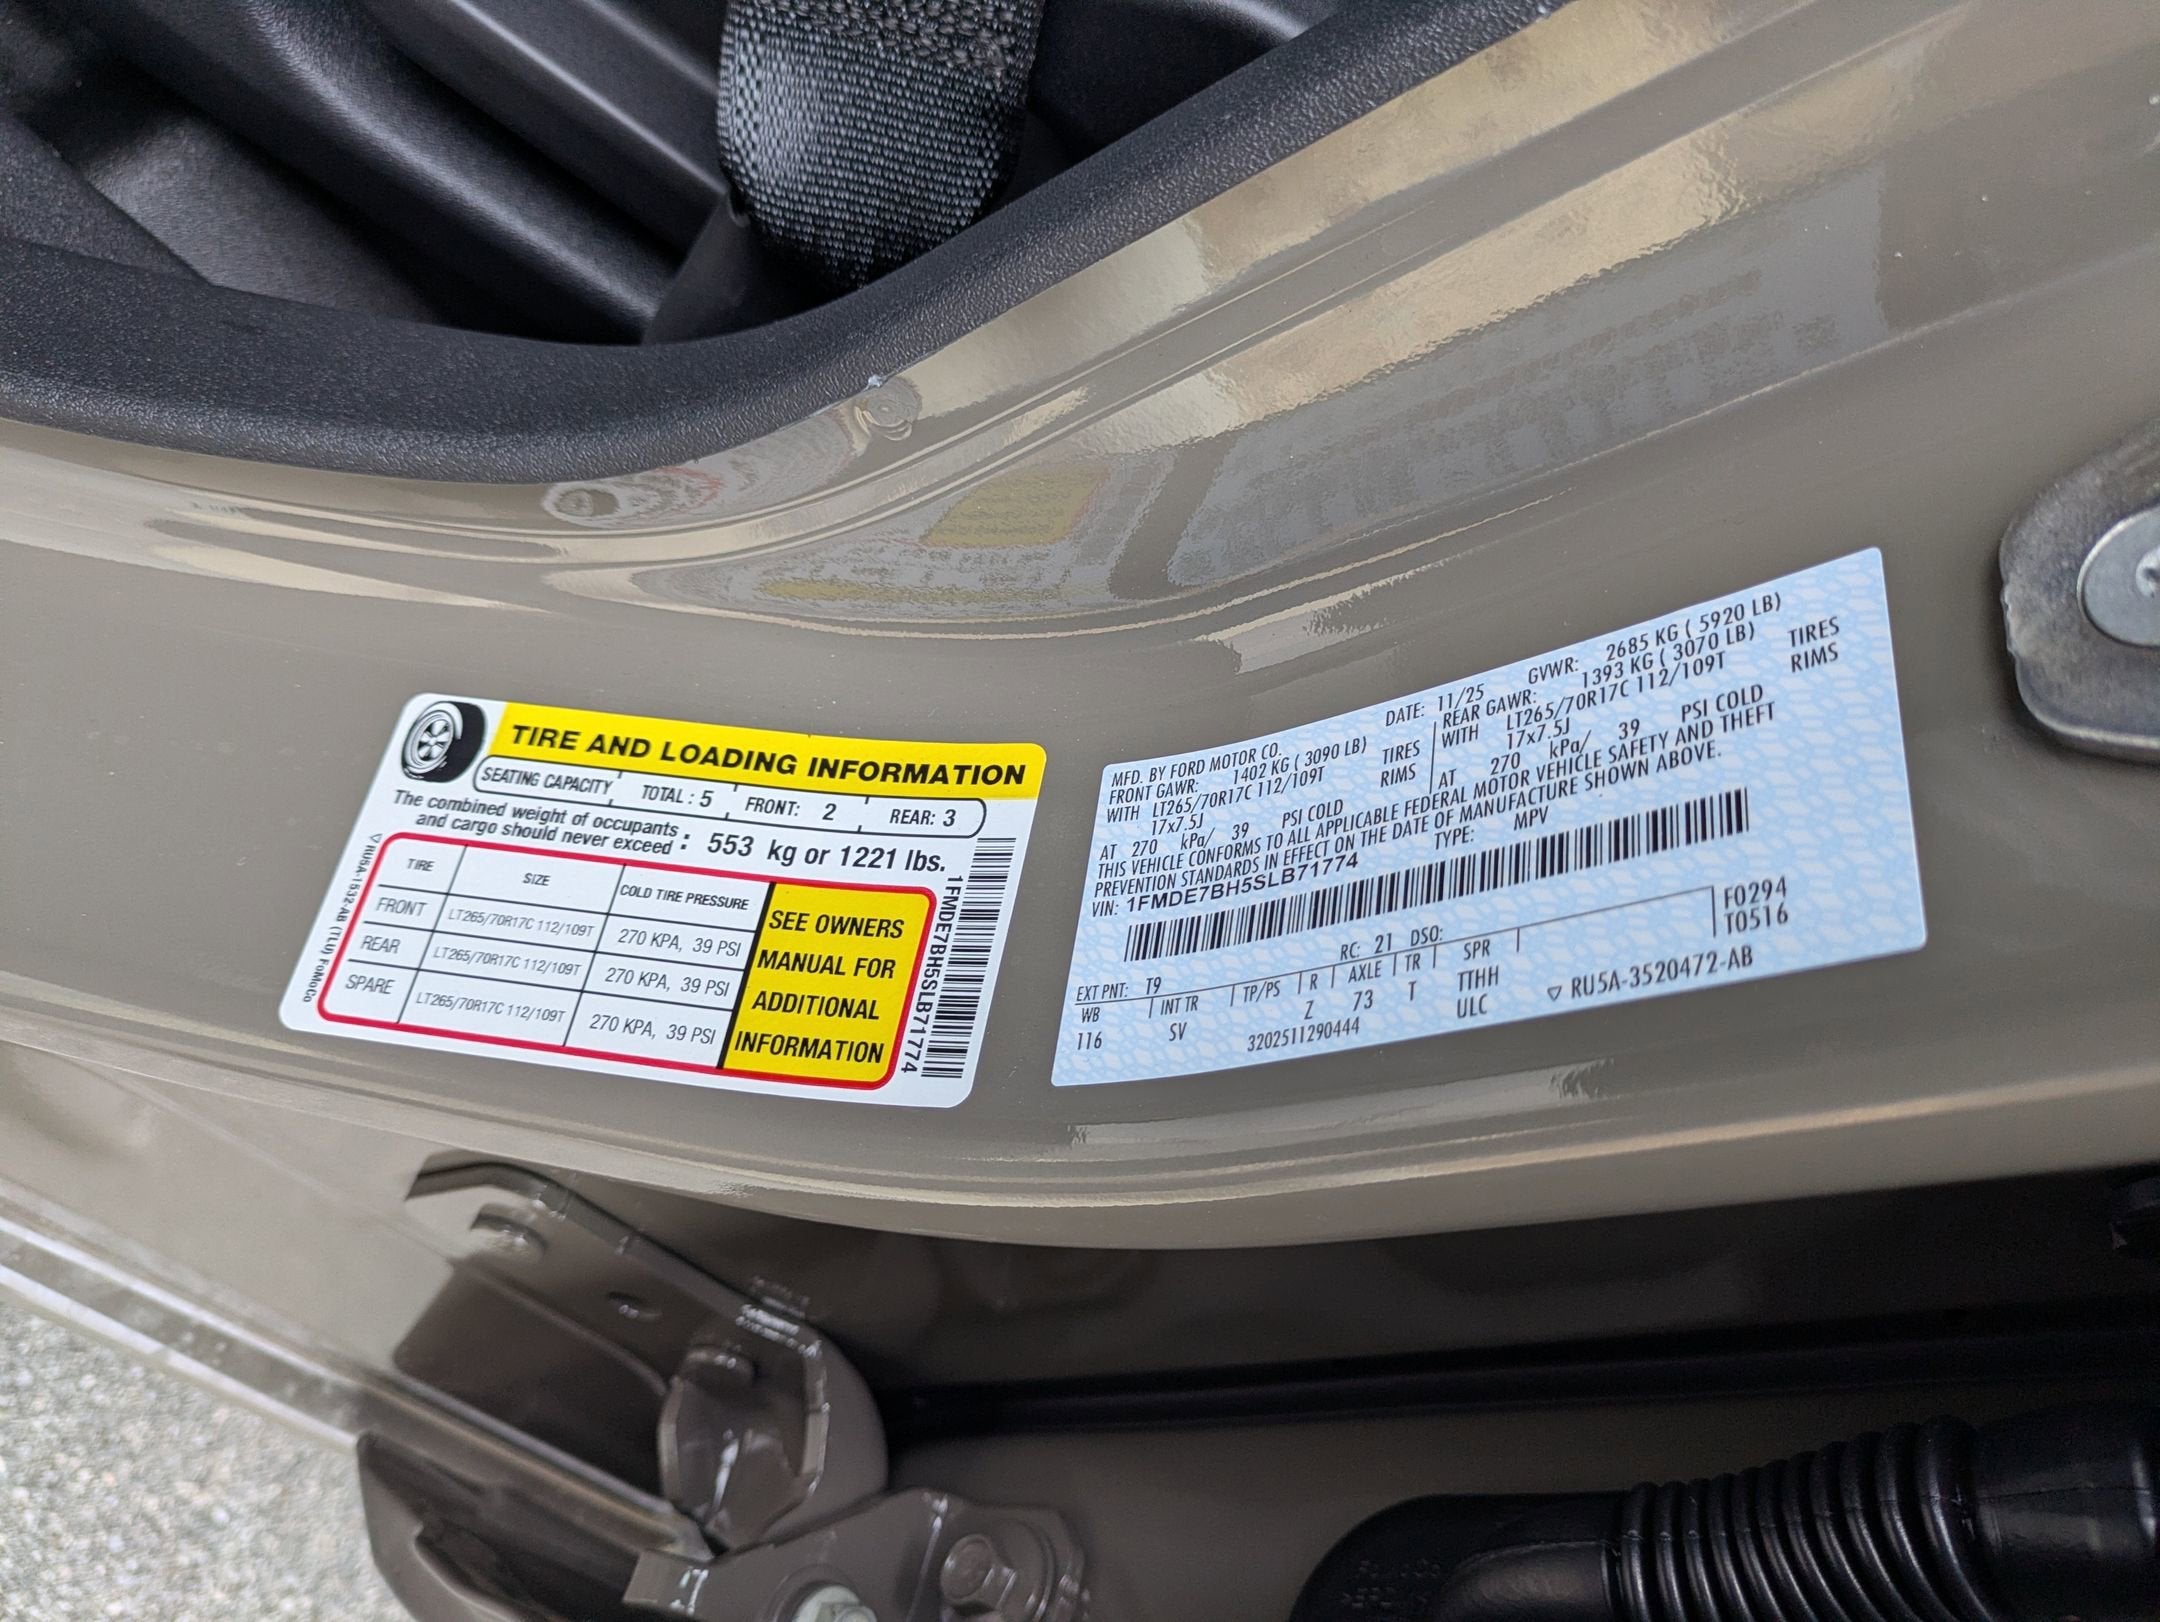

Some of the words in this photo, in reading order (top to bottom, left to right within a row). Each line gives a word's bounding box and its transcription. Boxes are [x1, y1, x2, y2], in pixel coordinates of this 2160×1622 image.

[1528, 657, 1579, 684] GVWR:
[1607, 633, 1648, 662] 2685
[1656, 624, 1679, 647] KG
[1700, 603, 1745, 632] 5920
[1752, 592, 1781, 616] LB)
[1442, 724, 1478, 748] WITH
[1507, 680, 1629, 731] LT265/70R17C
[1637, 651, 1725, 693] 112/109T
[1788, 616, 1840, 648] TIRES
[1443, 704, 1480, 729] REAR
[1486, 689, 1537, 716] GAWR:
[1583, 662, 1624, 688] 1393
[1631, 652, 1653, 674] KG
[1673, 632, 1719, 661] 3070
[1726, 621, 1755, 646] LB)
[1386, 702, 1424, 726] DATE:
[1439, 684, 1484, 711] 11/25
[1508, 717, 1570, 749] 17x7.5J
[1791, 642, 1839, 673] RIMS
[1438, 769, 1456, 789] AT
[1491, 752, 1521, 776] 270
[1550, 730, 1591, 759] kPa/
[1618, 718, 1640, 740] 39
[1681, 699, 1708, 723] PSI
[1716, 684, 1763, 712] COLD
[512, 725, 580, 750] TIRE
[587, 735, 651, 759] AND
[660, 741, 797, 775] LOADING
[808, 758, 1025, 785] INFORMATION
[1112, 770, 1142, 786] MFD.
[1150, 767, 1166, 782] BY
[1170, 760, 1205, 779] FORD
[1209, 749, 1256, 772] MOTOR
[1261, 742, 1282, 758] CO.
[482, 767, 539, 787] SEATING
[543, 773, 613, 795] CAPACITY
[1107, 806, 1140, 823] WITH
[1153, 784, 1251, 817] LT265/70R17C
[1258, 766, 1325, 798] 112/109T
[1382, 740, 1421, 764] TIRES
[1109, 785, 1152, 804] FRONT
[1156, 779, 1199, 798] GAWR:
[1234, 763, 1266, 784] 1402
[1271, 757, 1289, 775] KG
[1305, 743, 1339, 766] 3090
[1345, 736, 1367, 756] LB)
[642, 785, 683, 803] TOTAL
[699, 790, 713, 807] 5
[1099, 861, 1126, 879] THIS
[1132, 853, 1184, 875] VEHICLE
[1189, 838, 1261, 867] CONFORMS
[1267, 833, 1283, 849] TO
[1287, 828, 1310, 846] ALL
[1315, 803, 1399, 839] APPLICABLE
[1404, 786, 1465, 817] FEDERAL
[1474, 769, 1529, 800] MOTOR
[1537, 749, 1602, 781] VEHICLE
[1608, 731, 1668, 764] SAFETY
[1675, 720, 1713, 746] AND
[1720, 701, 1775, 733] THEFT
[1152, 813, 1204, 835] 17x7.5J
[1380, 763, 1416, 787] RIMS
[395, 790, 422, 806] The
[427, 795, 505, 816] combined
[512, 804, 566, 827] weight
[572, 811, 588, 826] of
[592, 817, 679, 839] occupants
[746, 797, 800, 816] FRONT:
[823, 804, 836, 820] 2
[890, 809, 936, 826] REAR:
[943, 810, 956, 827] 3
[1095, 874, 1176, 897] PREVENTION
[1182, 856, 1259, 887] STANDARDS
[1265, 852, 1278, 870] IN
[1283, 840, 1330, 866] EFFECT
[1335, 833, 1355, 853] ON
[1361, 827, 1386, 847] THE
[1392, 816, 1428, 839] DATE
[1434, 809, 1454, 828] OF
[1460, 777, 1578, 823] MANUFACTURE
[1585, 758, 1649, 791] SHOWN
[1656, 740, 1721, 773] ABOVE.
[416, 811, 446, 828] and
[451, 818, 498, 837] cargo
[502, 823, 557, 841] should
[561, 832, 610, 847] never
[613, 834, 673, 854] exceed
[1100, 844, 1117, 860] AT
[1132, 839, 1158, 857] 270
[1181, 827, 1215, 850] kPa/
[1232, 822, 1249, 840] 39
[1282, 808, 1302, 829] PSI
[1308, 800, 1344, 822] COLD
[1434, 827, 1474, 850] TYPE:
[1514, 806, 1548, 831] MPV
[406, 859, 434, 871] TIRE
[708, 833, 754, 855] 553
[768, 840, 796, 868] kg
[804, 848, 830, 865] or
[841, 846, 896, 868] 1221
[905, 850, 945, 871] lbs.
[523, 873, 550, 886] SIZE
[1092, 900, 1118, 917] VIN:
[1127, 852, 1358, 912] 1FMDE7BH5SLB71774
[376, 898, 427, 916] FRONT
[620, 885, 652, 898] COLD
[656, 889, 683, 903] TIRE
[685, 893, 749, 910] PRESSURE
[448, 909, 534, 929] LT265/70R17C
[538, 916, 594, 937] 112/109T
[769, 910, 810, 931] SEE
[816, 914, 904, 938] OWNERS
[320, 926, 343, 954] (TLU)
[361, 936, 400, 954] REAR
[618, 929, 647, 945] 270
[650, 933, 683, 951] KPA,
[693, 938, 713, 953] 39
[716, 941, 741, 957] PSI
[1340, 944, 1360, 960] RC:
[1375, 933, 1392, 954] 21
[1410, 925, 1443, 946] DSO:
[1464, 939, 1491, 960] SPR
[758, 950, 846, 976] MANUAL
[854, 958, 896, 978] FOR
[901, 875, 963, 1073] 1FMDE7BH5SLB71774
[1348, 961, 1382, 983] AXLE
[1405, 953, 1420, 971] TR
[1571, 945, 1753, 999] RU5A-3520472-AB
[303, 959, 329, 1002] FoMoCo
[346, 975, 395, 995] SPARE
[1077, 985, 1100, 1001] EXT
[1102, 983, 1129, 999] PNT:
[1146, 977, 1161, 995] T9
[1244, 981, 1280, 1002] TP/PS
[1310, 974, 1317, 990] R
[1409, 981, 1417, 1001] T
[1457, 966, 1499, 992] TTHH
[752, 991, 880, 1020] ADDITIONAL
[1161, 998, 1182, 1015] INT
[1186, 996, 1199, 1012] TR
[1304, 1001, 1313, 1019] Z
[1353, 990, 1373, 1011] 73
[1457, 994, 1488, 1018] ULC
[1082, 1007, 1100, 1023] WB
[1077, 1032, 1102, 1050] 116
[1169, 1022, 1187, 1041] SV
[1248, 1017, 1360, 1052] 3202511290444
[734, 1031, 884, 1063] INFORMATION
